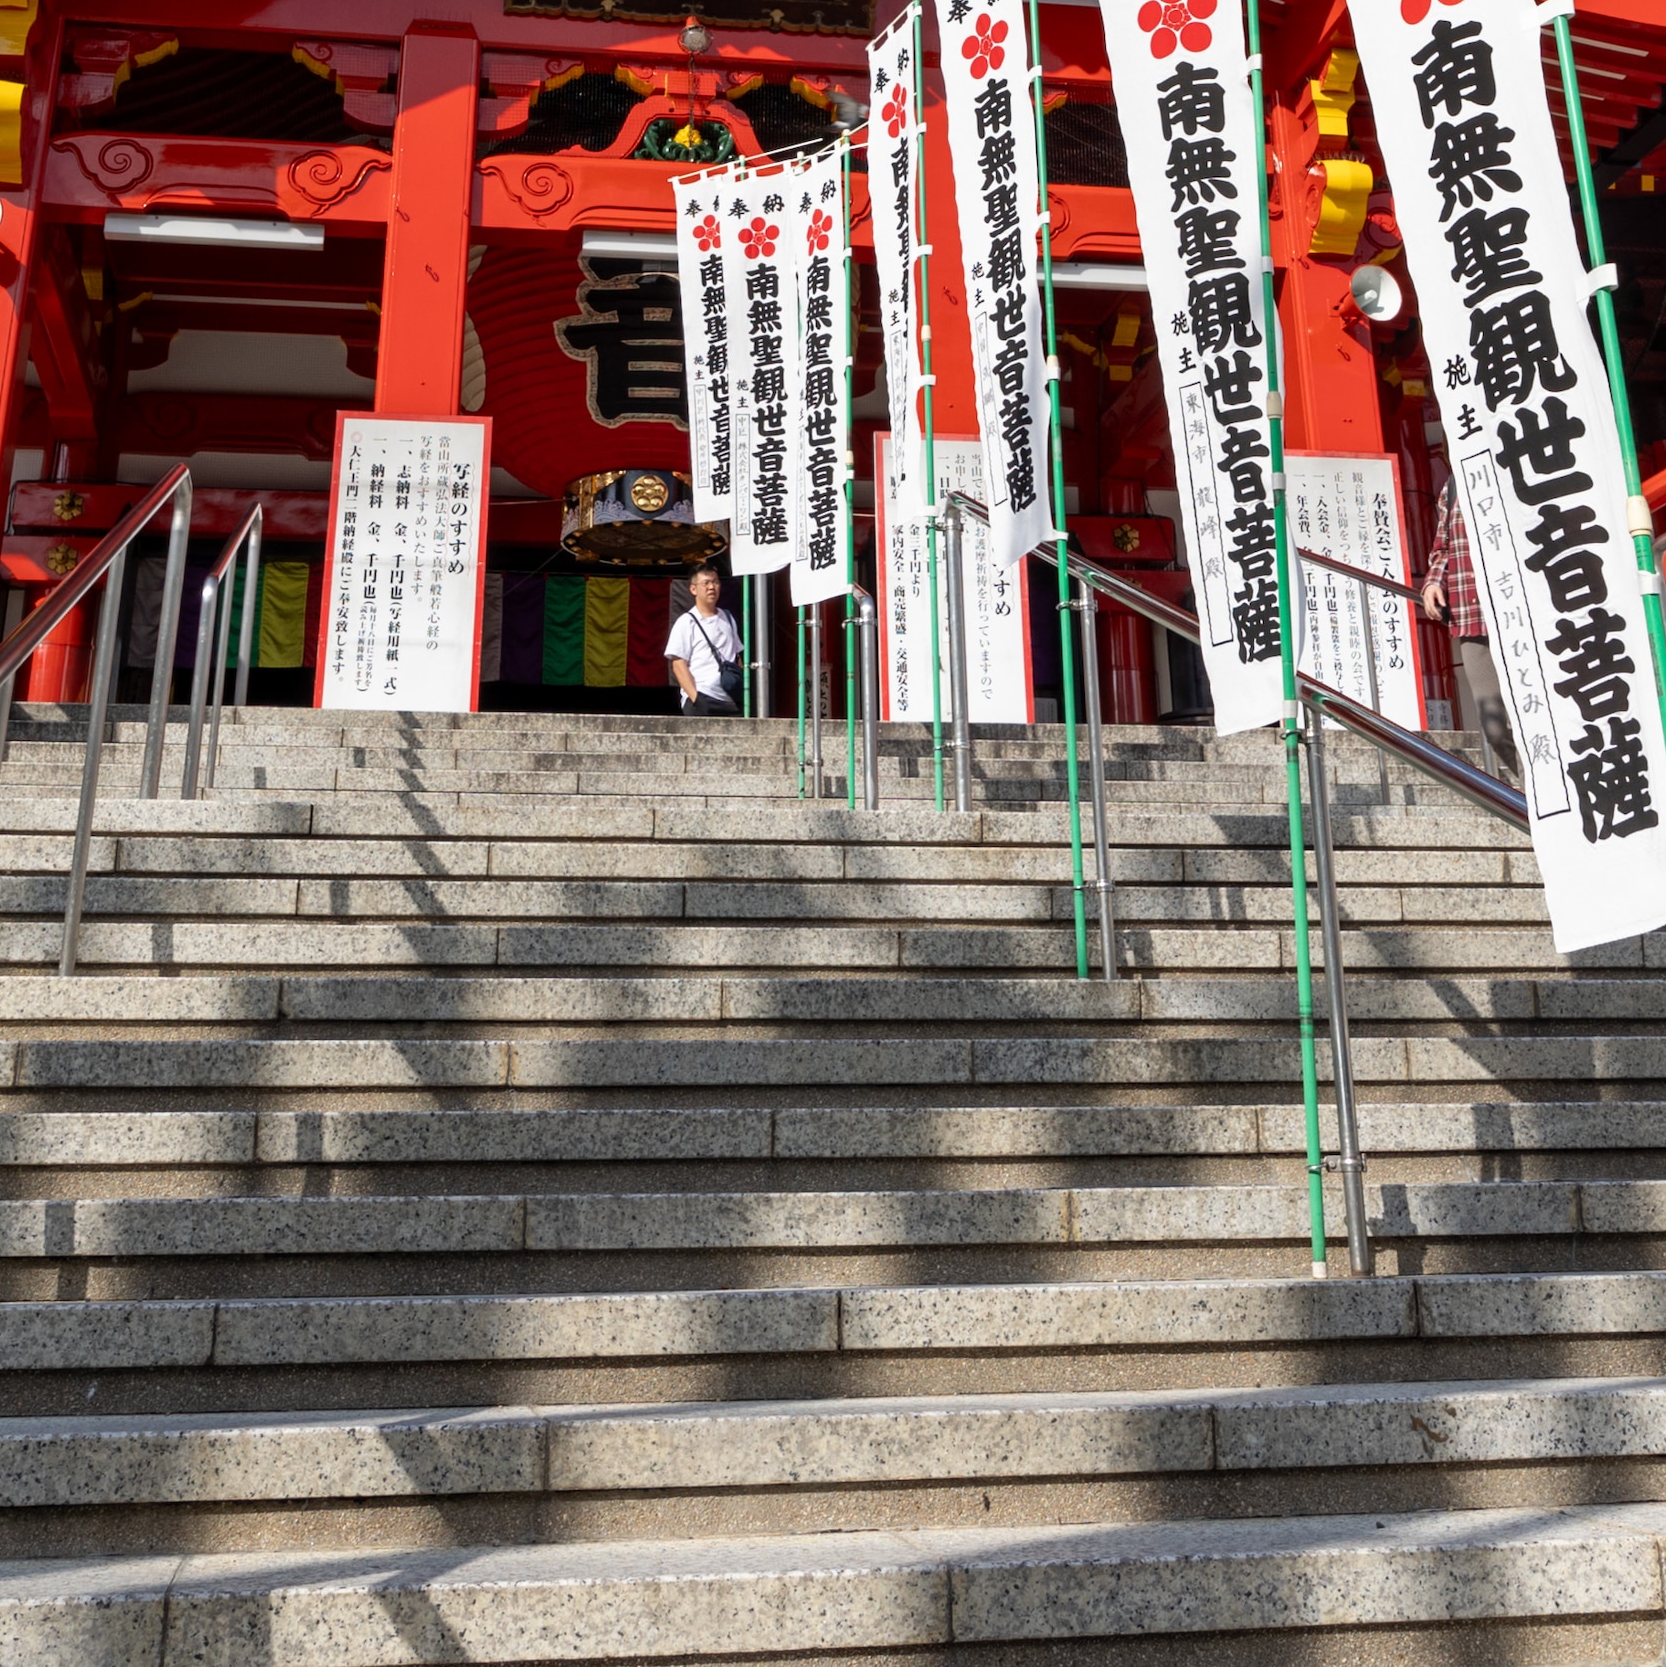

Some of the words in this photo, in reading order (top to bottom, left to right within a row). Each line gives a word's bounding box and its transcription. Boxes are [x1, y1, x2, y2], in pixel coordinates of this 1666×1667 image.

[729, 193, 785, 219] 奉納
[800, 179, 836, 214] 奉納
[974, 78, 1037, 514] 南無聖観世音菩薩
[745, 262, 789, 546] 南無聖観世音菩薩
[805, 255, 838, 571] 南無聖観世音菩薩
[1156, 61, 1282, 664] 南無聖観世音菩薩
[1171, 311, 1197, 374] 施主
[1412, 20, 1659, 844] 南無聖観世音菩薩
[1443, 354, 1483, 441] 施主
[447, 463, 471, 575] 写経のすすめ
[1469, 463, 1504, 552] 川口市
[1494, 569, 1546, 716] 吉川ひとみ
